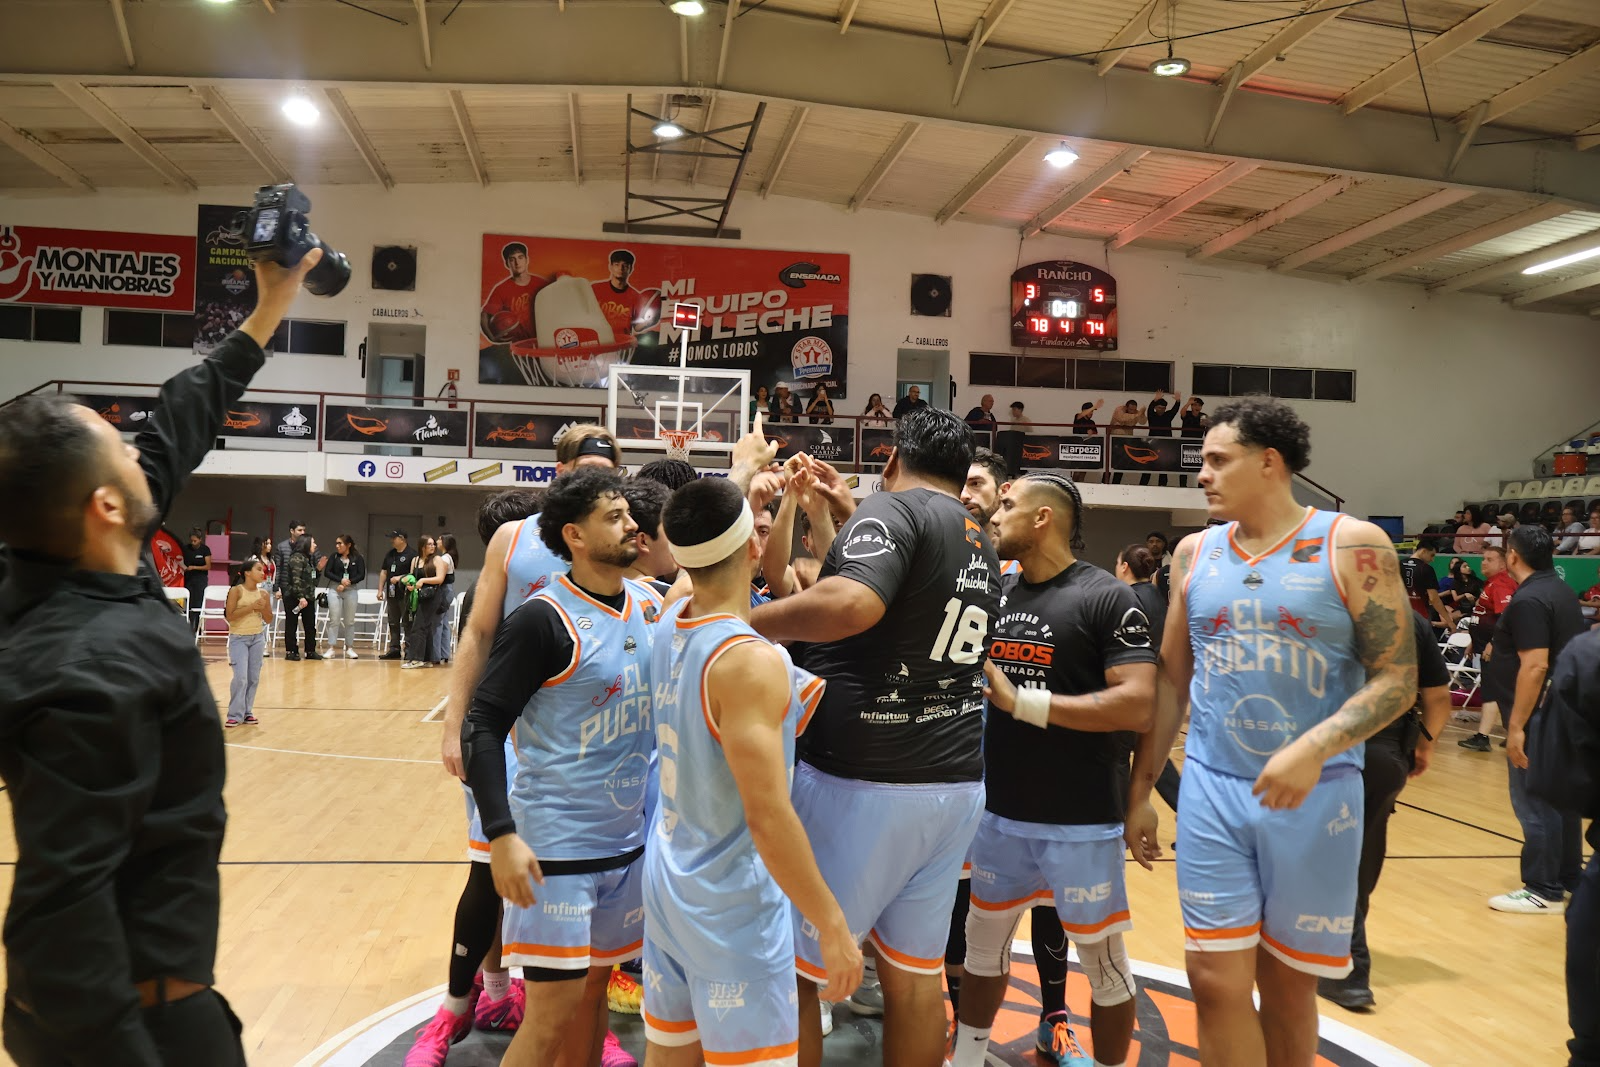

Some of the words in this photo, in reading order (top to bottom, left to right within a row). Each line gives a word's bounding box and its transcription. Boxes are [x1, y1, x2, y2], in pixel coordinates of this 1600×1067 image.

[36, 249, 178, 277] MONTAJES
[39, 271, 54, 287] Y
[57, 273, 172, 294] MANIOBRAS
[790, 272, 841, 281] ENSENADA
[1037, 268, 1092, 281] RANCHO
[661, 278, 695, 296] MI
[1026, 284, 1036, 299] 3
[1094, 288, 1104, 303] 5
[372, 308, 409, 318] CABALLEROS
[711, 304, 834, 340] LECHE
[1030, 318, 1049, 333] 78
[1060, 320, 1070, 333] 4
[1086, 321, 1105, 335] 74
[796, 340, 812, 354] STAR
[813, 340, 829, 355] MILK
[915, 337, 949, 347] CABALLEROS
[668, 344, 718, 362] #OMOS
[722, 341, 759, 359] LOBOS
[842, 534, 896, 556] NISSAN
[967, 553, 988, 571] Salsa
[1354, 549, 1378, 572] R
[956, 568, 990, 594] Huichol
[1232, 599, 1275, 631] EL
[929, 596, 988, 665] 18
[1041, 624, 1053, 639] DE
[988, 641, 1054, 665] OBOS
[1203, 634, 1327, 699] PUERTO
[623, 663, 648, 696] EL
[860, 711, 909, 721] infinitum
[1223, 716, 1297, 732] NISSAN
